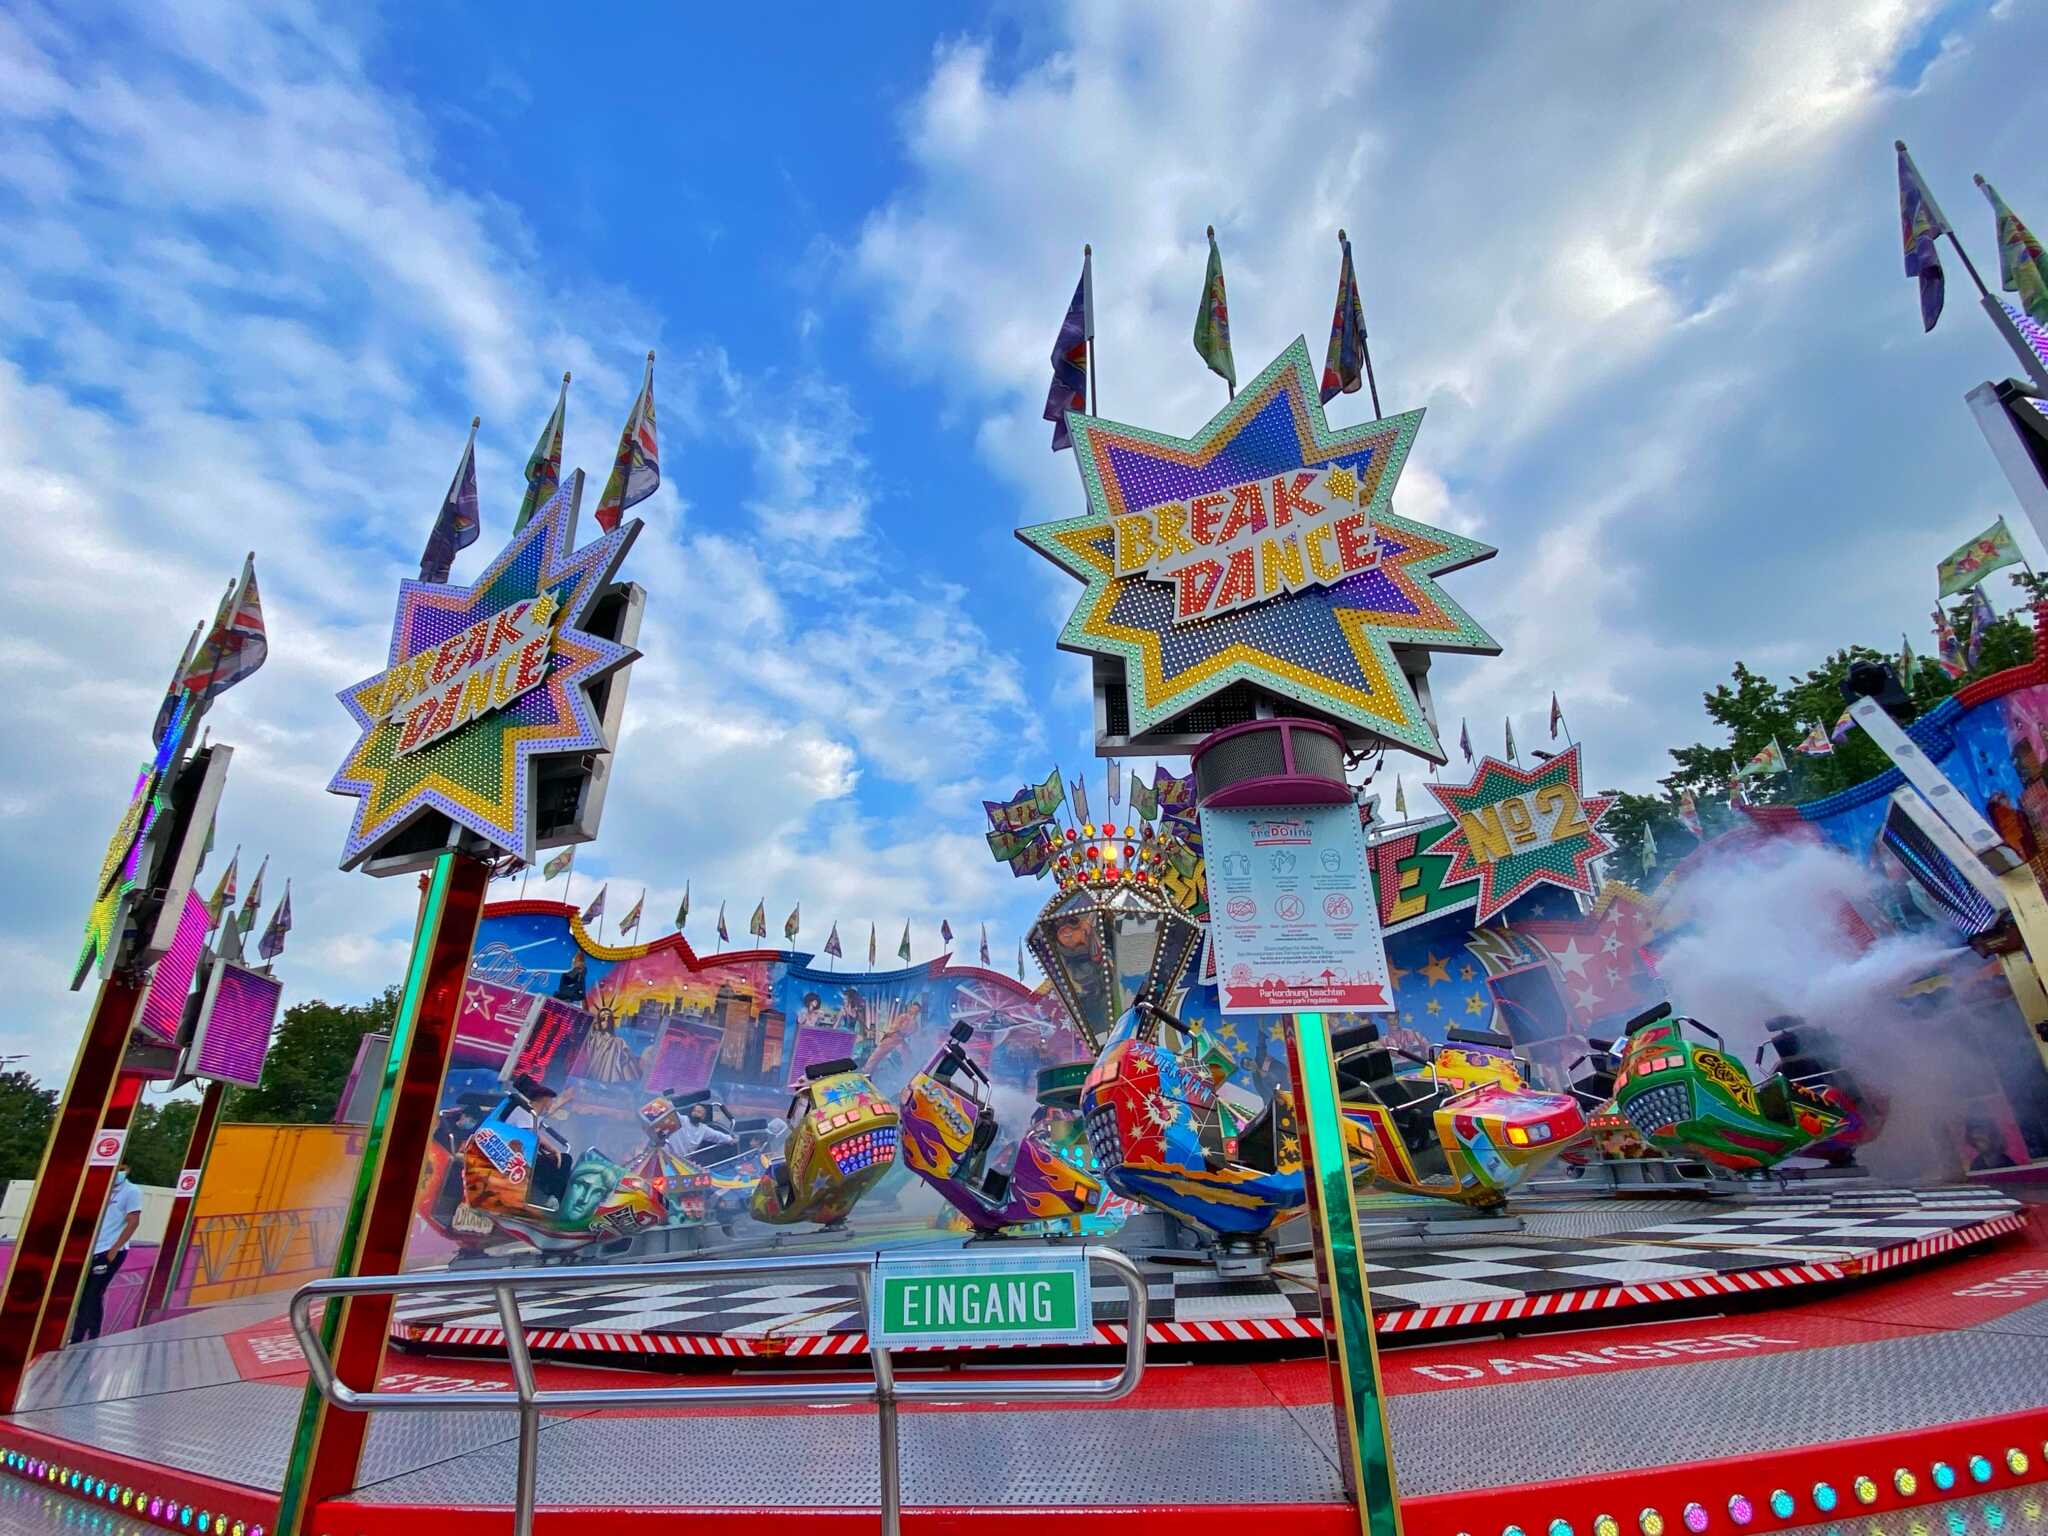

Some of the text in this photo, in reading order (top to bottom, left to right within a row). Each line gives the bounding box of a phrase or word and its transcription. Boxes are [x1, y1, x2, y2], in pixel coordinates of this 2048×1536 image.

[1116, 472, 1326, 571] BREAK
[1162, 511, 1378, 617] DANCE
[371, 602, 531, 718] BREAK
[397, 633, 549, 752] DANCE
[1535, 782, 1591, 842] 2
[903, 1281, 1053, 1326] EINGANG
[1410, 1333, 1799, 1383] DANGER
